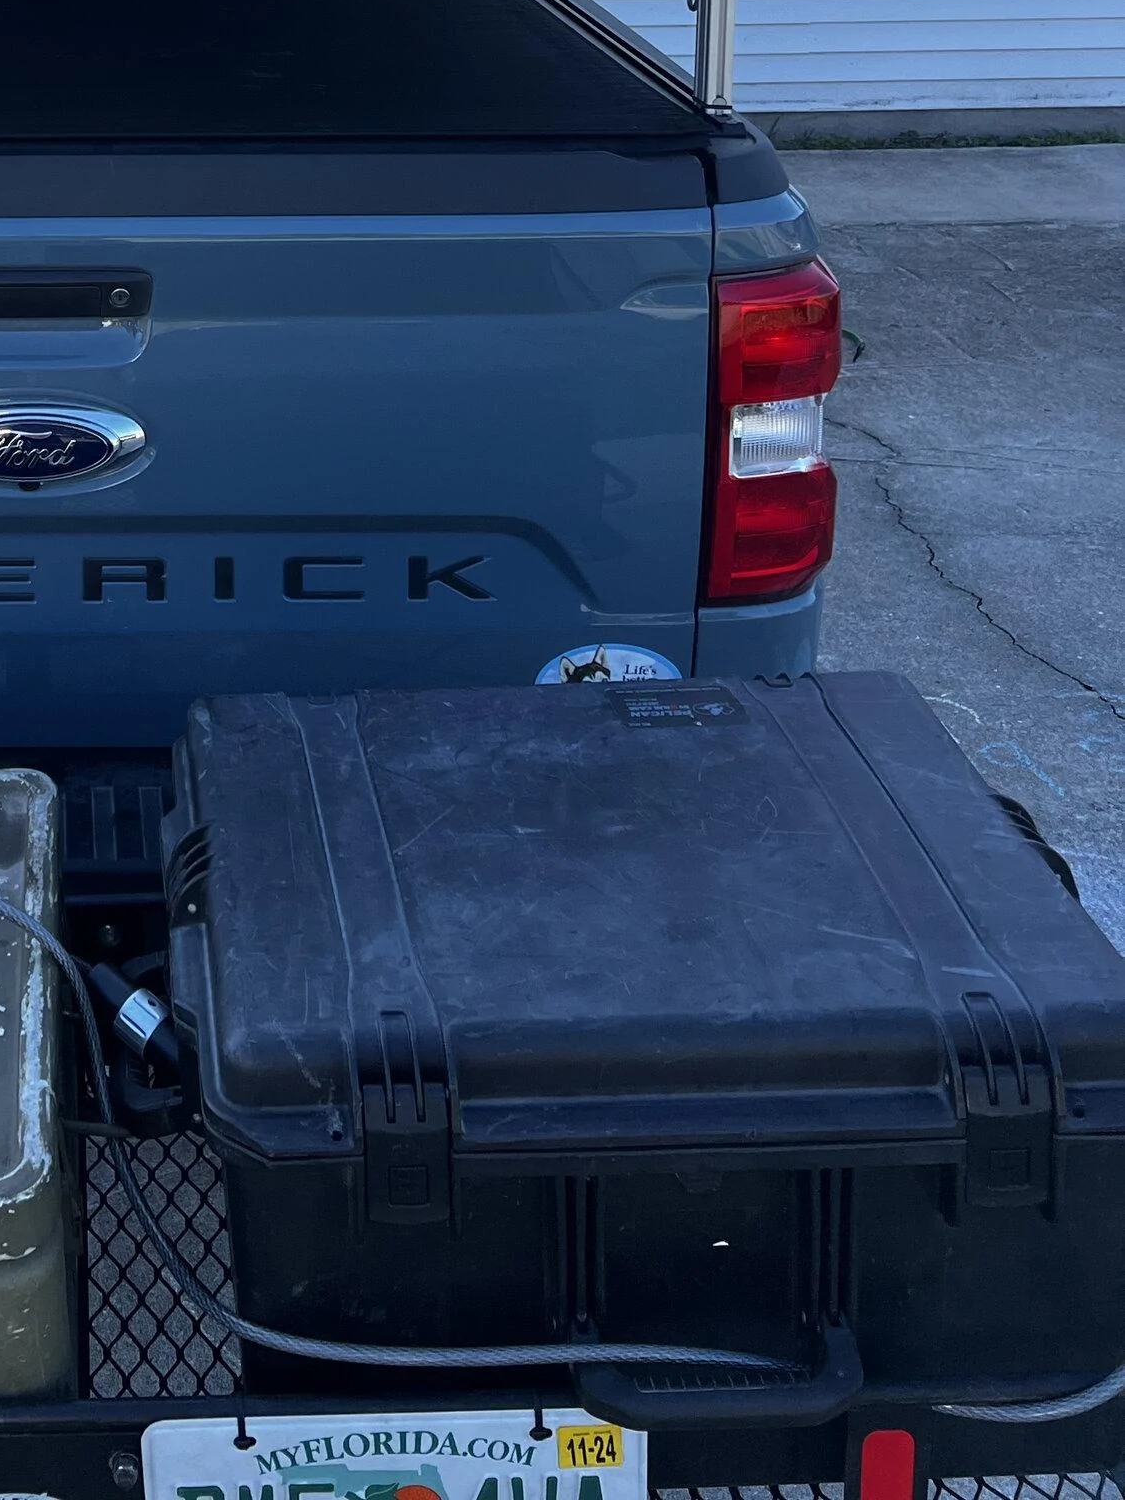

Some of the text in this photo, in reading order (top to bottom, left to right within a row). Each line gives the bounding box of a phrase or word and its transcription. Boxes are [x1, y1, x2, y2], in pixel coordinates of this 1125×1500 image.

[623, 664, 657, 676] Life's
[253, 1430, 538, 1475] MYFLORIDA.COM
[567, 1434, 617, 1467] 11-24
